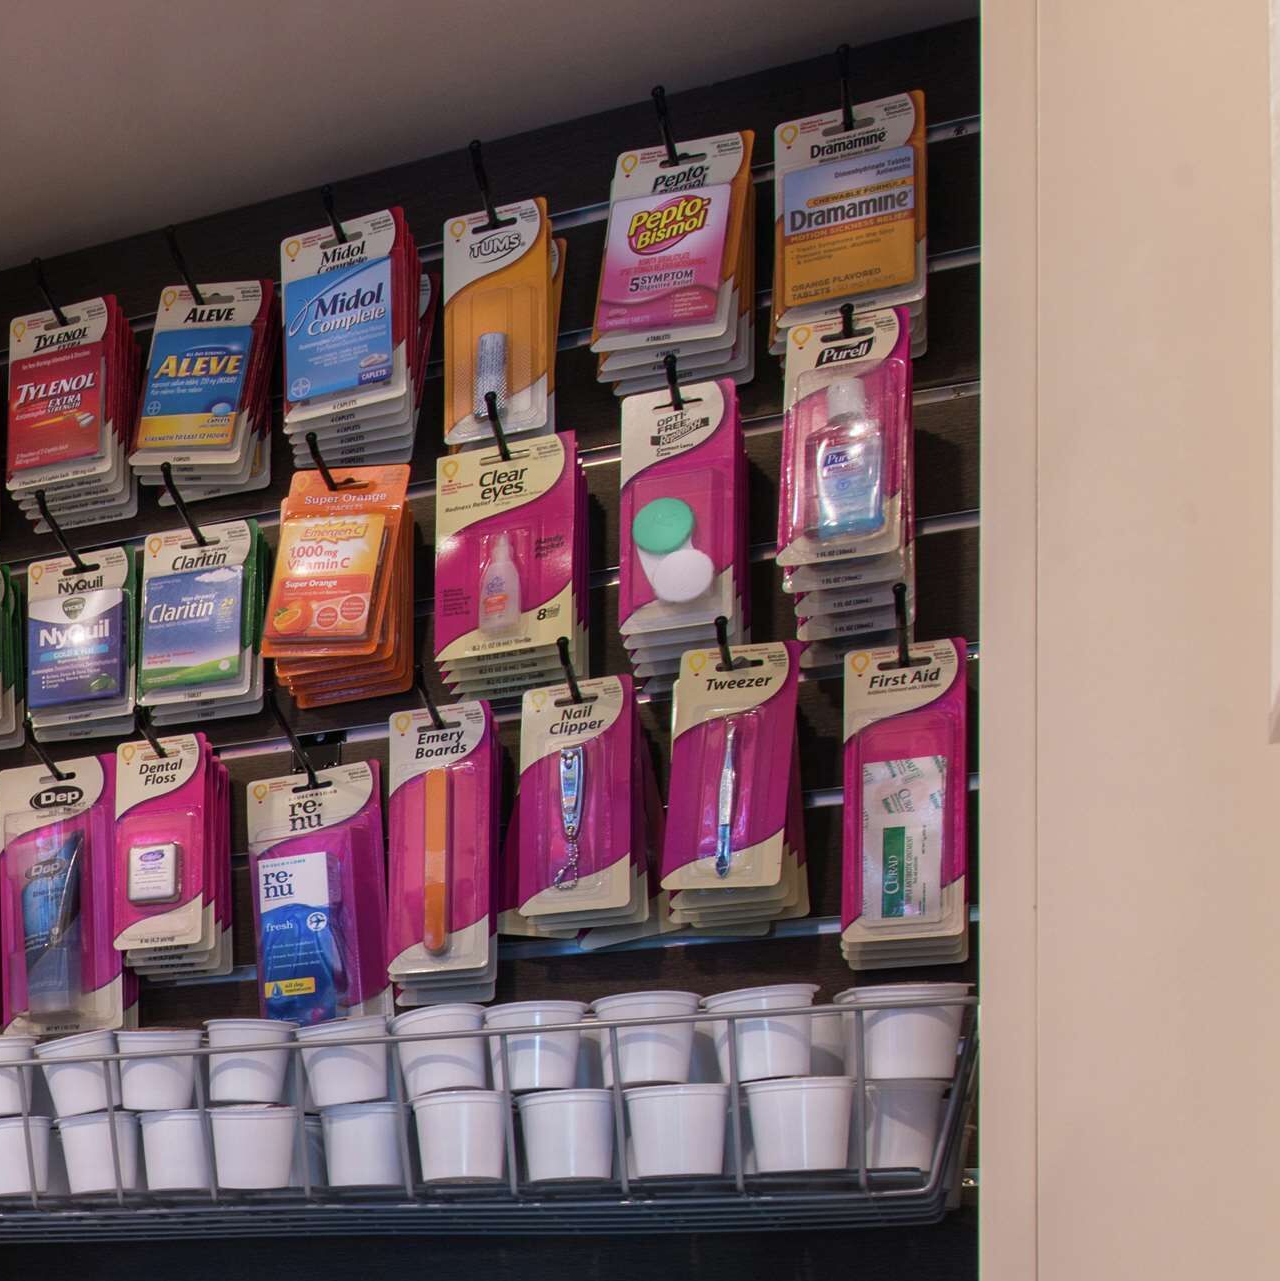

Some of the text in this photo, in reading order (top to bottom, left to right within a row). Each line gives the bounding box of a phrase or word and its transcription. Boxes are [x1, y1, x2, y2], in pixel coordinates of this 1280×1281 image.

[810, 131, 887, 159] Dramamine
[652, 165, 711, 192] Pepto-
[629, 198, 711, 237] Pepto-
[791, 190, 909, 232] Dramamine
[637, 216, 708, 250] Bismol
[321, 241, 365, 267] Midol
[469, 232, 520, 259] TUMS
[629, 270, 694, 292] 5 SYMPTOM
[314, 282, 383, 320] Midol
[184, 308, 235, 323] ALEVE
[308, 306, 386, 337] Complete
[34, 327, 89, 353] TYLENOL
[822, 342, 869, 364] Purell
[154, 355, 242, 378] ALEVE
[16, 373, 95, 408] TYLENOL
[48, 394, 81, 408] EXTRA
[479, 467, 527, 487] Clear
[305, 493, 386, 505] Super Orange
[481, 481, 524, 502] eyes
[172, 552, 227, 571] Claritin
[341, 558, 350, 568] C
[58, 576, 103, 595] NyQuil
[149, 600, 213, 624] Claritin
[537, 608, 545, 620] 8
[40, 619, 109, 648] NyQuil
[706, 672, 773, 692] Tweezer
[869, 668, 940, 688] First Aid
[560, 705, 593, 724] Nail
[417, 726, 465, 750] Emery
[549, 716, 604, 740] Clipper
[415, 740, 467, 761] Boards
[139, 759, 183, 777] Dental
[144, 770, 177, 786] Floss
[40, 790, 79, 805] Dep
[290, 814, 323, 832] nu
[264, 883, 294, 899] nu
[266, 920, 293, 932] fresh
